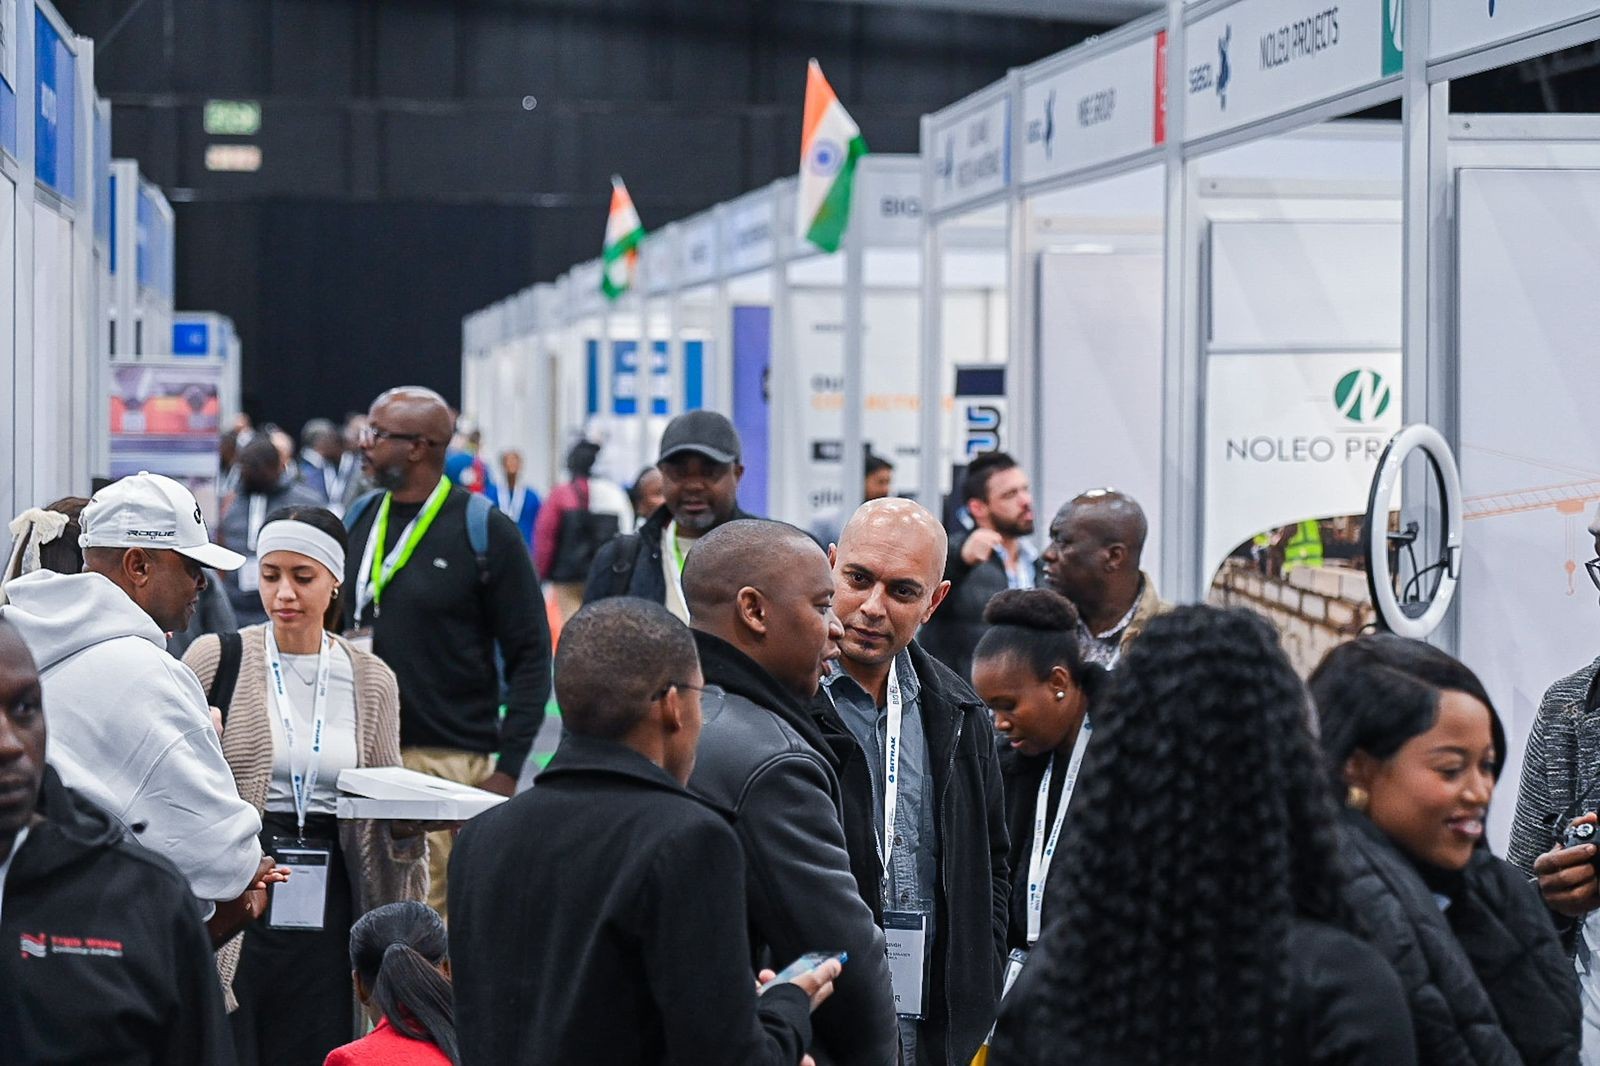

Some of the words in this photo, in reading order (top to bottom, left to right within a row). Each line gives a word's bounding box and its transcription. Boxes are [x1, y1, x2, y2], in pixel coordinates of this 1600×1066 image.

[1260, 27, 1290, 70] NOLEO
[1293, 6, 1340, 60] PROJECTS
[1226, 437, 1334, 461] NOLEO
